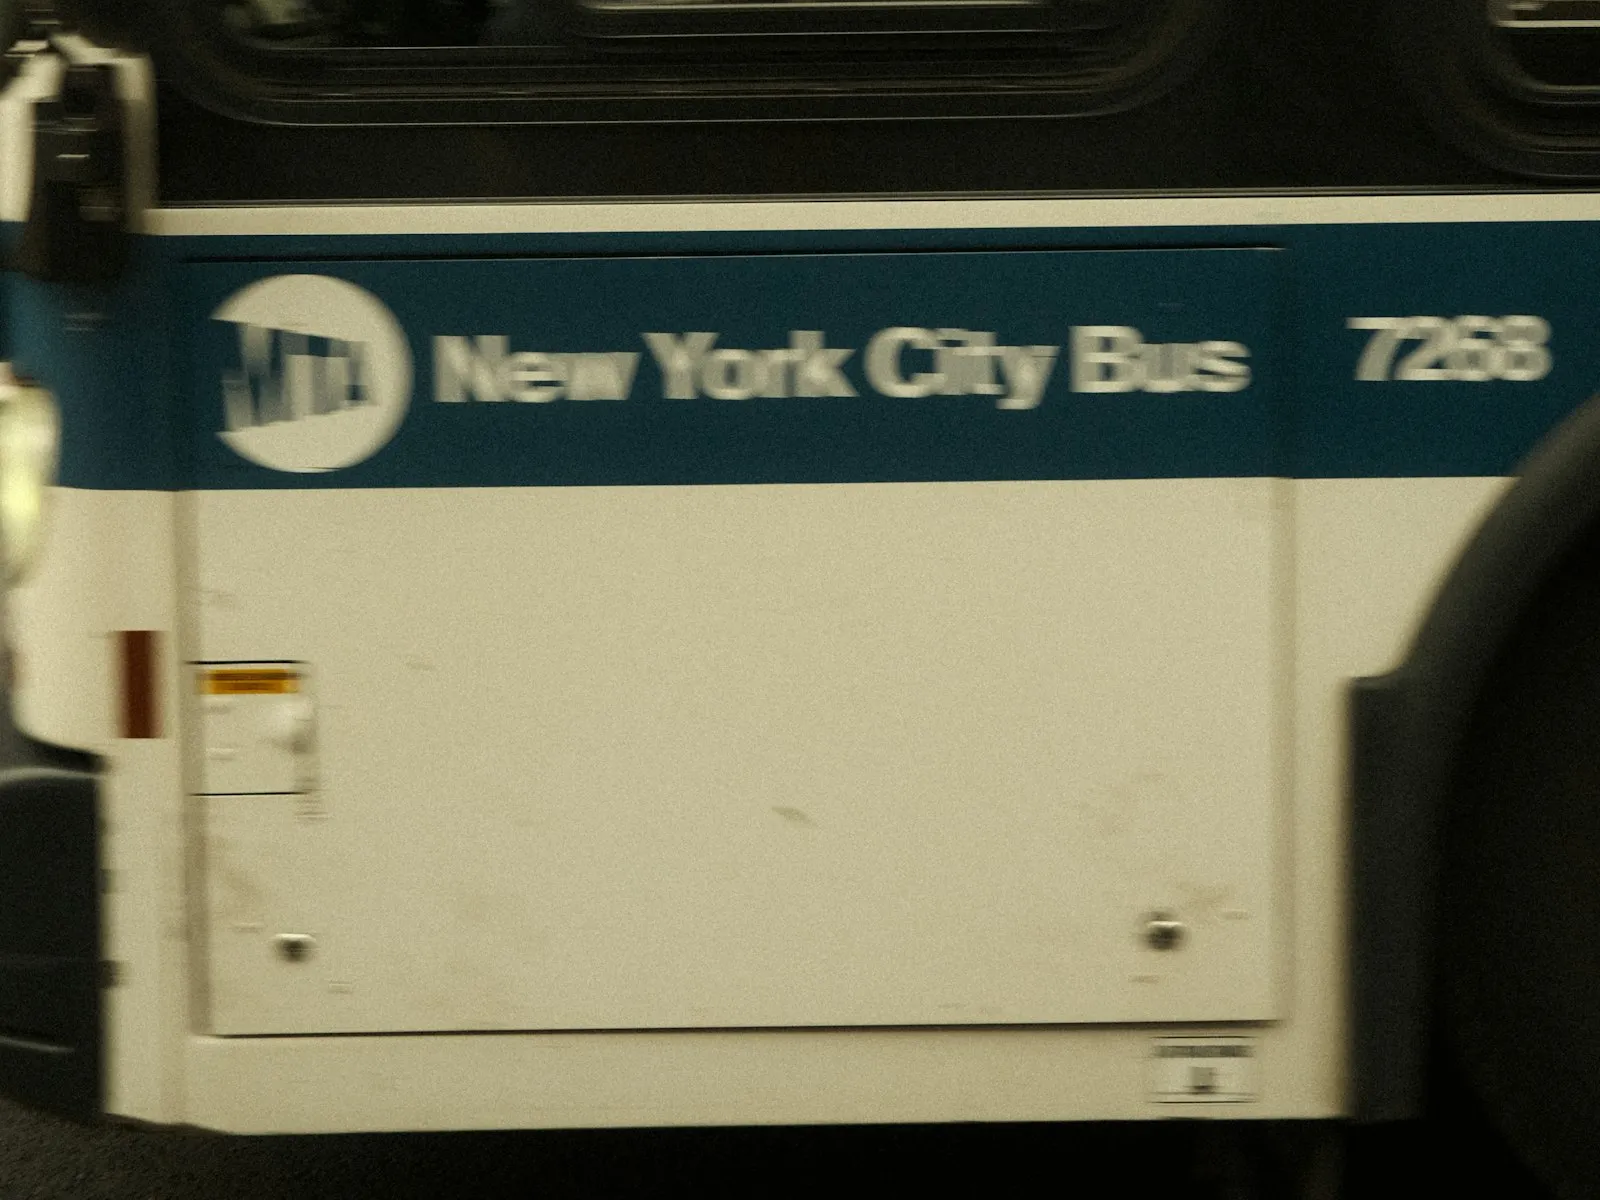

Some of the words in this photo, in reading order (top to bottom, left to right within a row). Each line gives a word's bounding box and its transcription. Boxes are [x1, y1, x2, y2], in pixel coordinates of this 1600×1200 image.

[432, 334, 640, 403] New
[641, 329, 858, 401] York
[863, 326, 1060, 411] City
[1069, 324, 1250, 394] Bus
[1346, 314, 1552, 382] 7268
